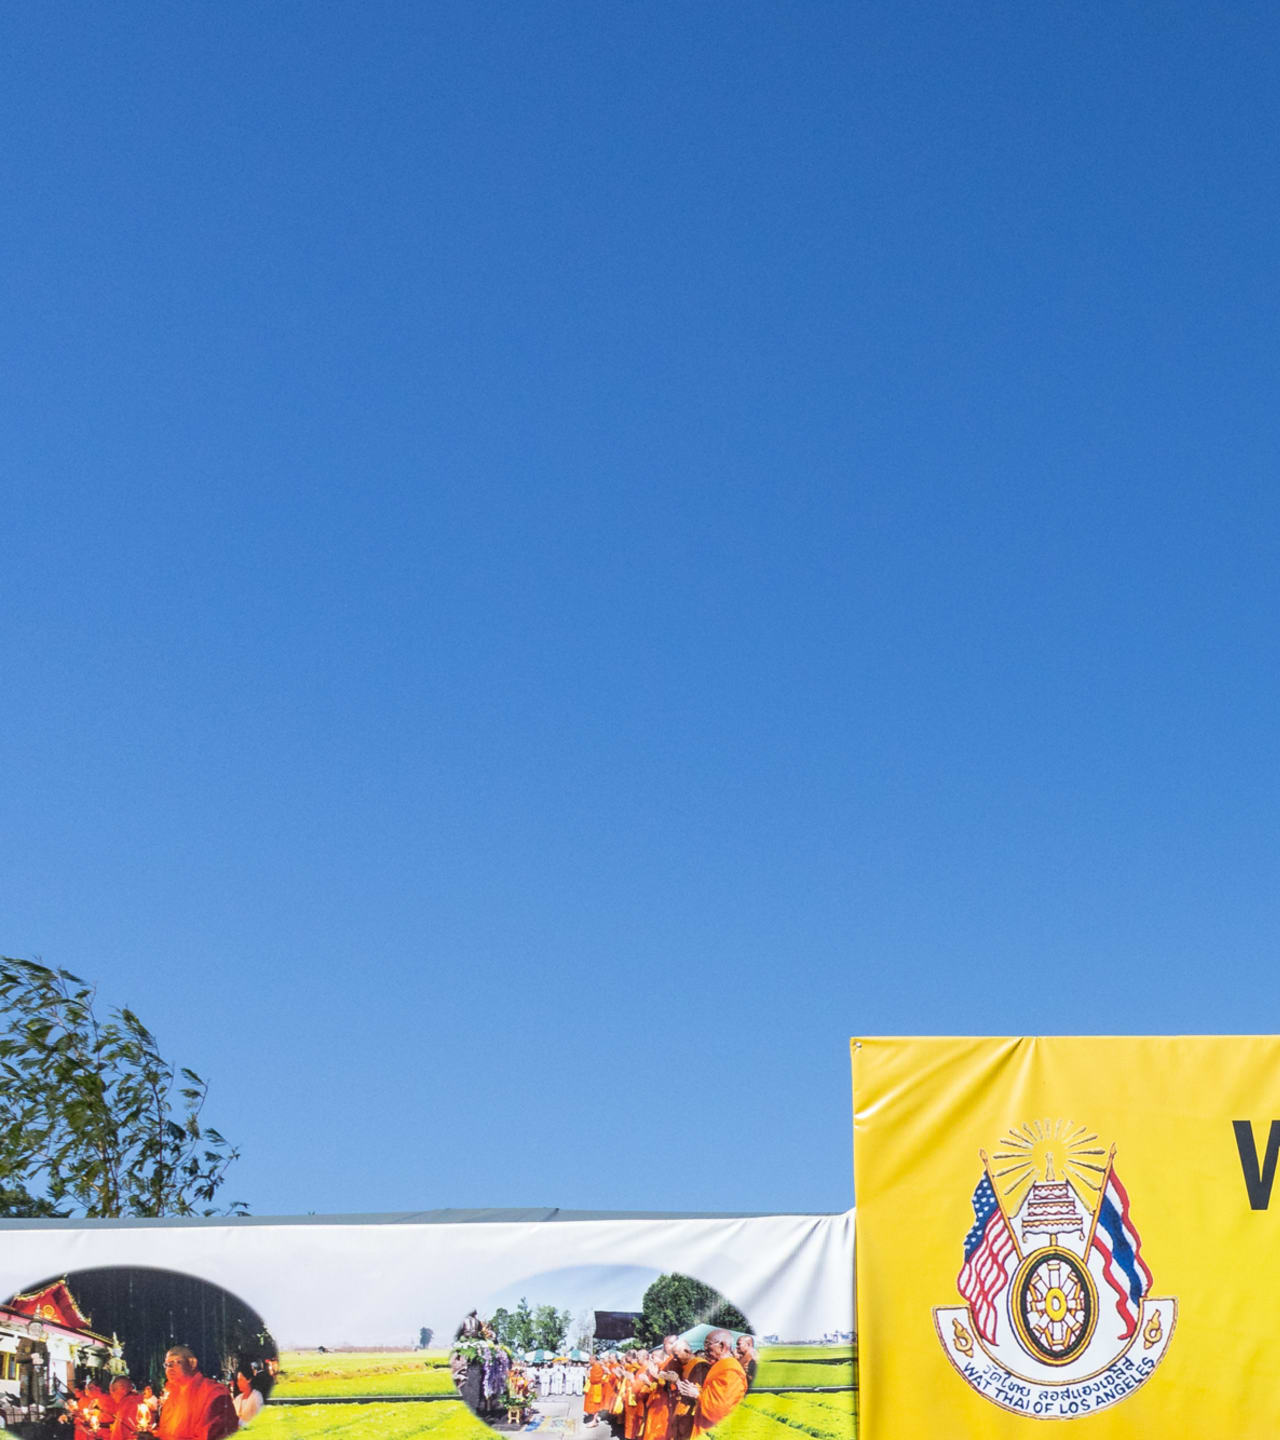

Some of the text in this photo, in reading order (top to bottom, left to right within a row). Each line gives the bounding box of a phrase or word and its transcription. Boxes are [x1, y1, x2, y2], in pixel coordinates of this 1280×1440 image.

[963, 1356, 1155, 1414] WAT THAI OF LOS ANGELES
